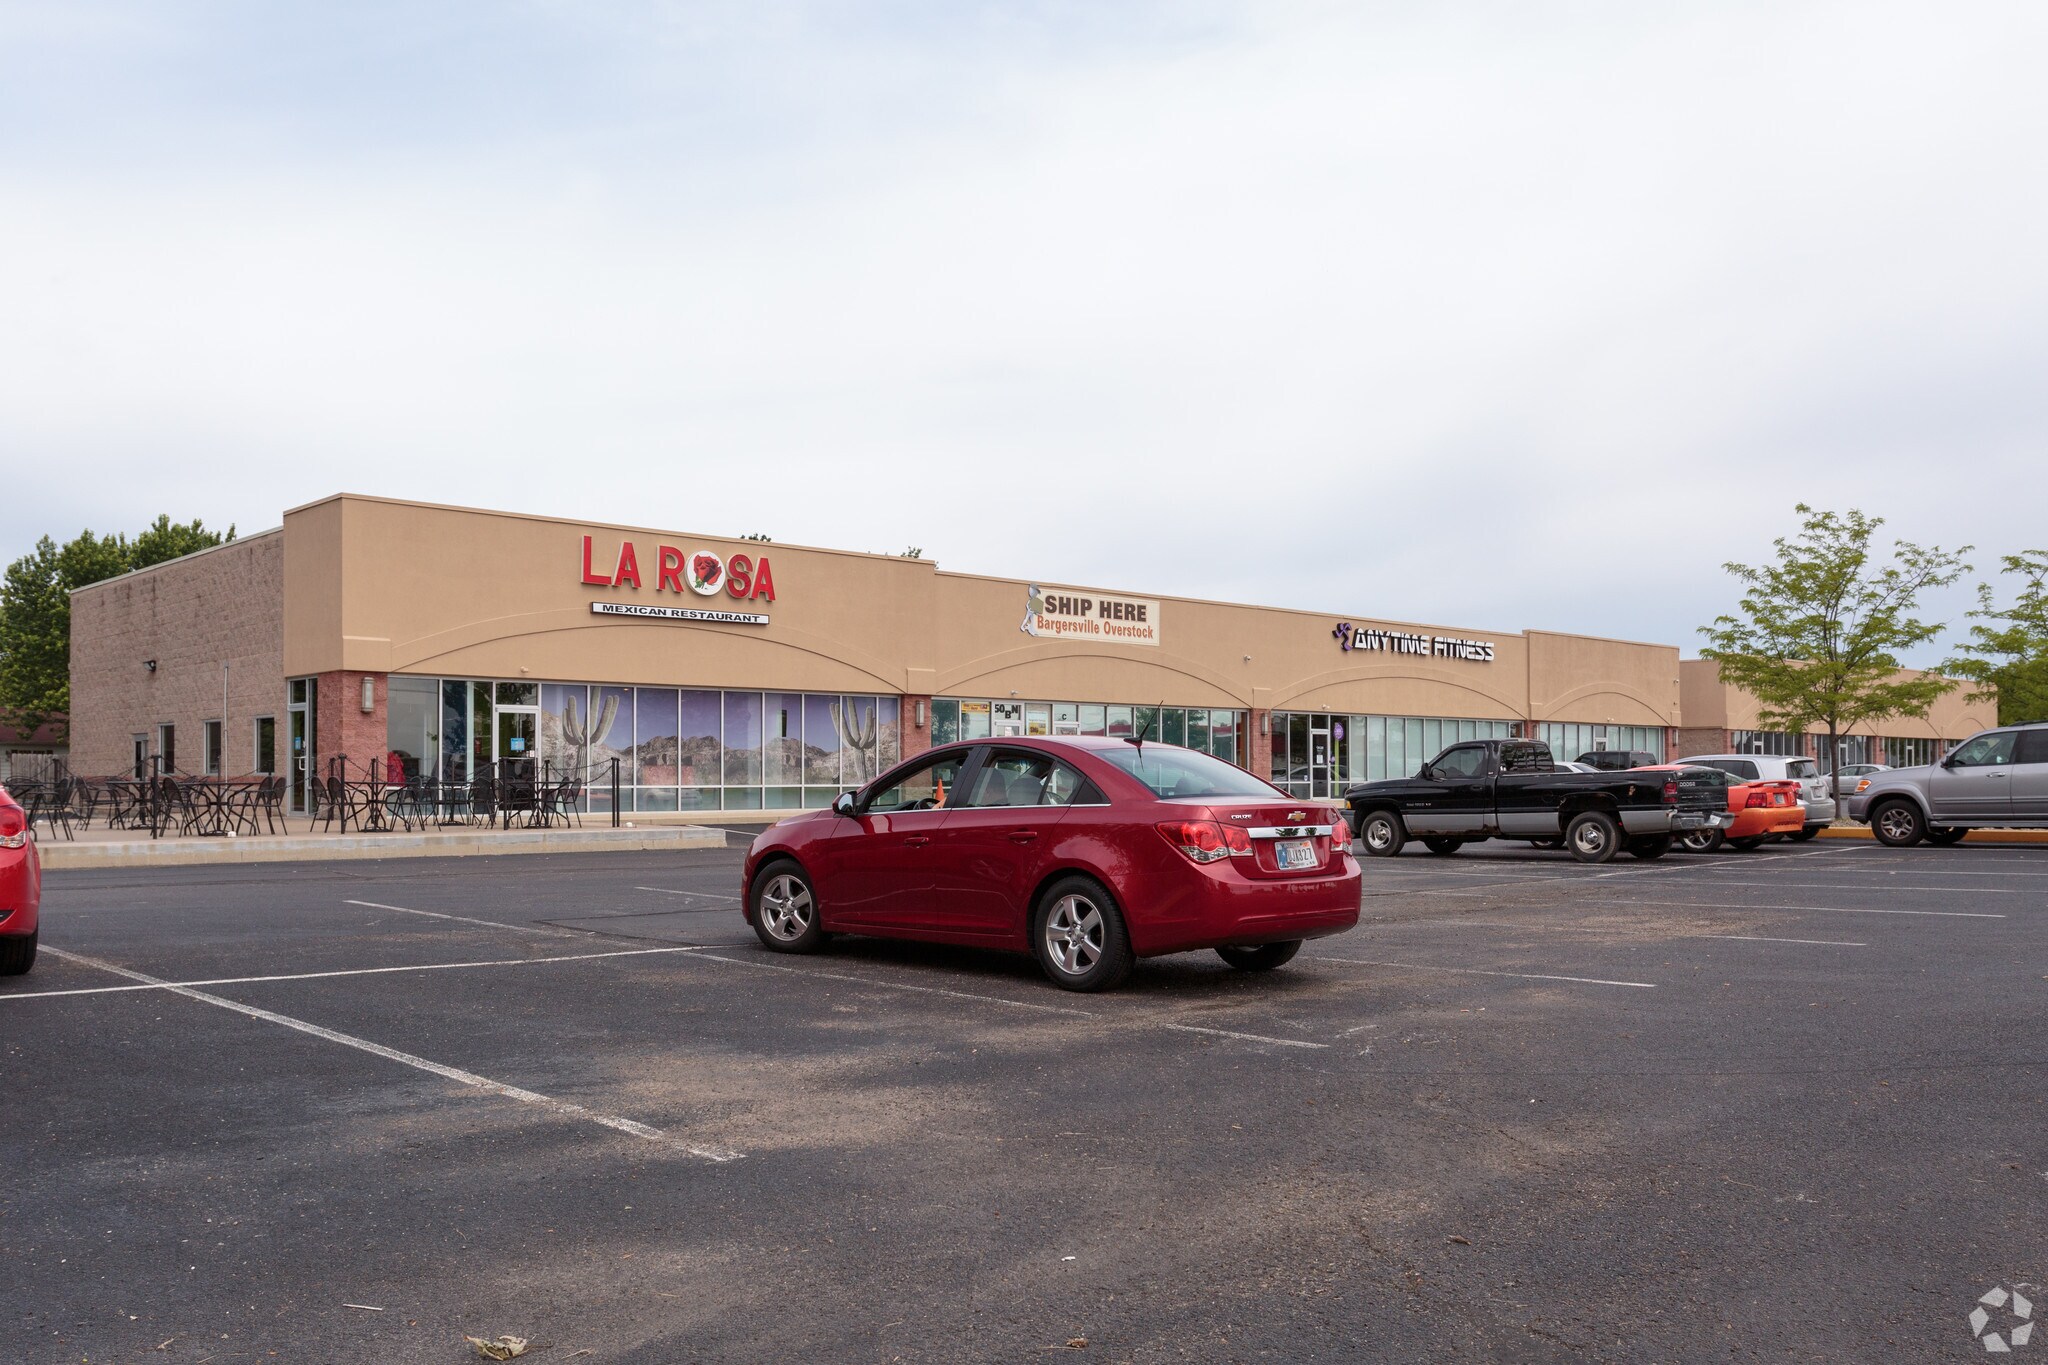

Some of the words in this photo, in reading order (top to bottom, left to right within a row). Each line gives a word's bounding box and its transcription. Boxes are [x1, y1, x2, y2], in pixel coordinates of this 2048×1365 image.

[580, 535, 642, 589] LA
[656, 545, 776, 602] ROSA
[602, 604, 668, 616] MEXICAN
[671, 609, 761, 623] RESTAURANT
[1044, 595, 1093, 617] SHIP
[1099, 600, 1147, 623] HERE
[1037, 615, 1100, 635] Bargersville
[1103, 621, 1154, 639] Overstock
[1354, 628, 1430, 656] ANYTIME
[1432, 636, 1495, 661] FITNESS
[994, 703, 1006, 714] 50
[1011, 704, 1019, 714] N
[1004, 710, 1012, 719] B
